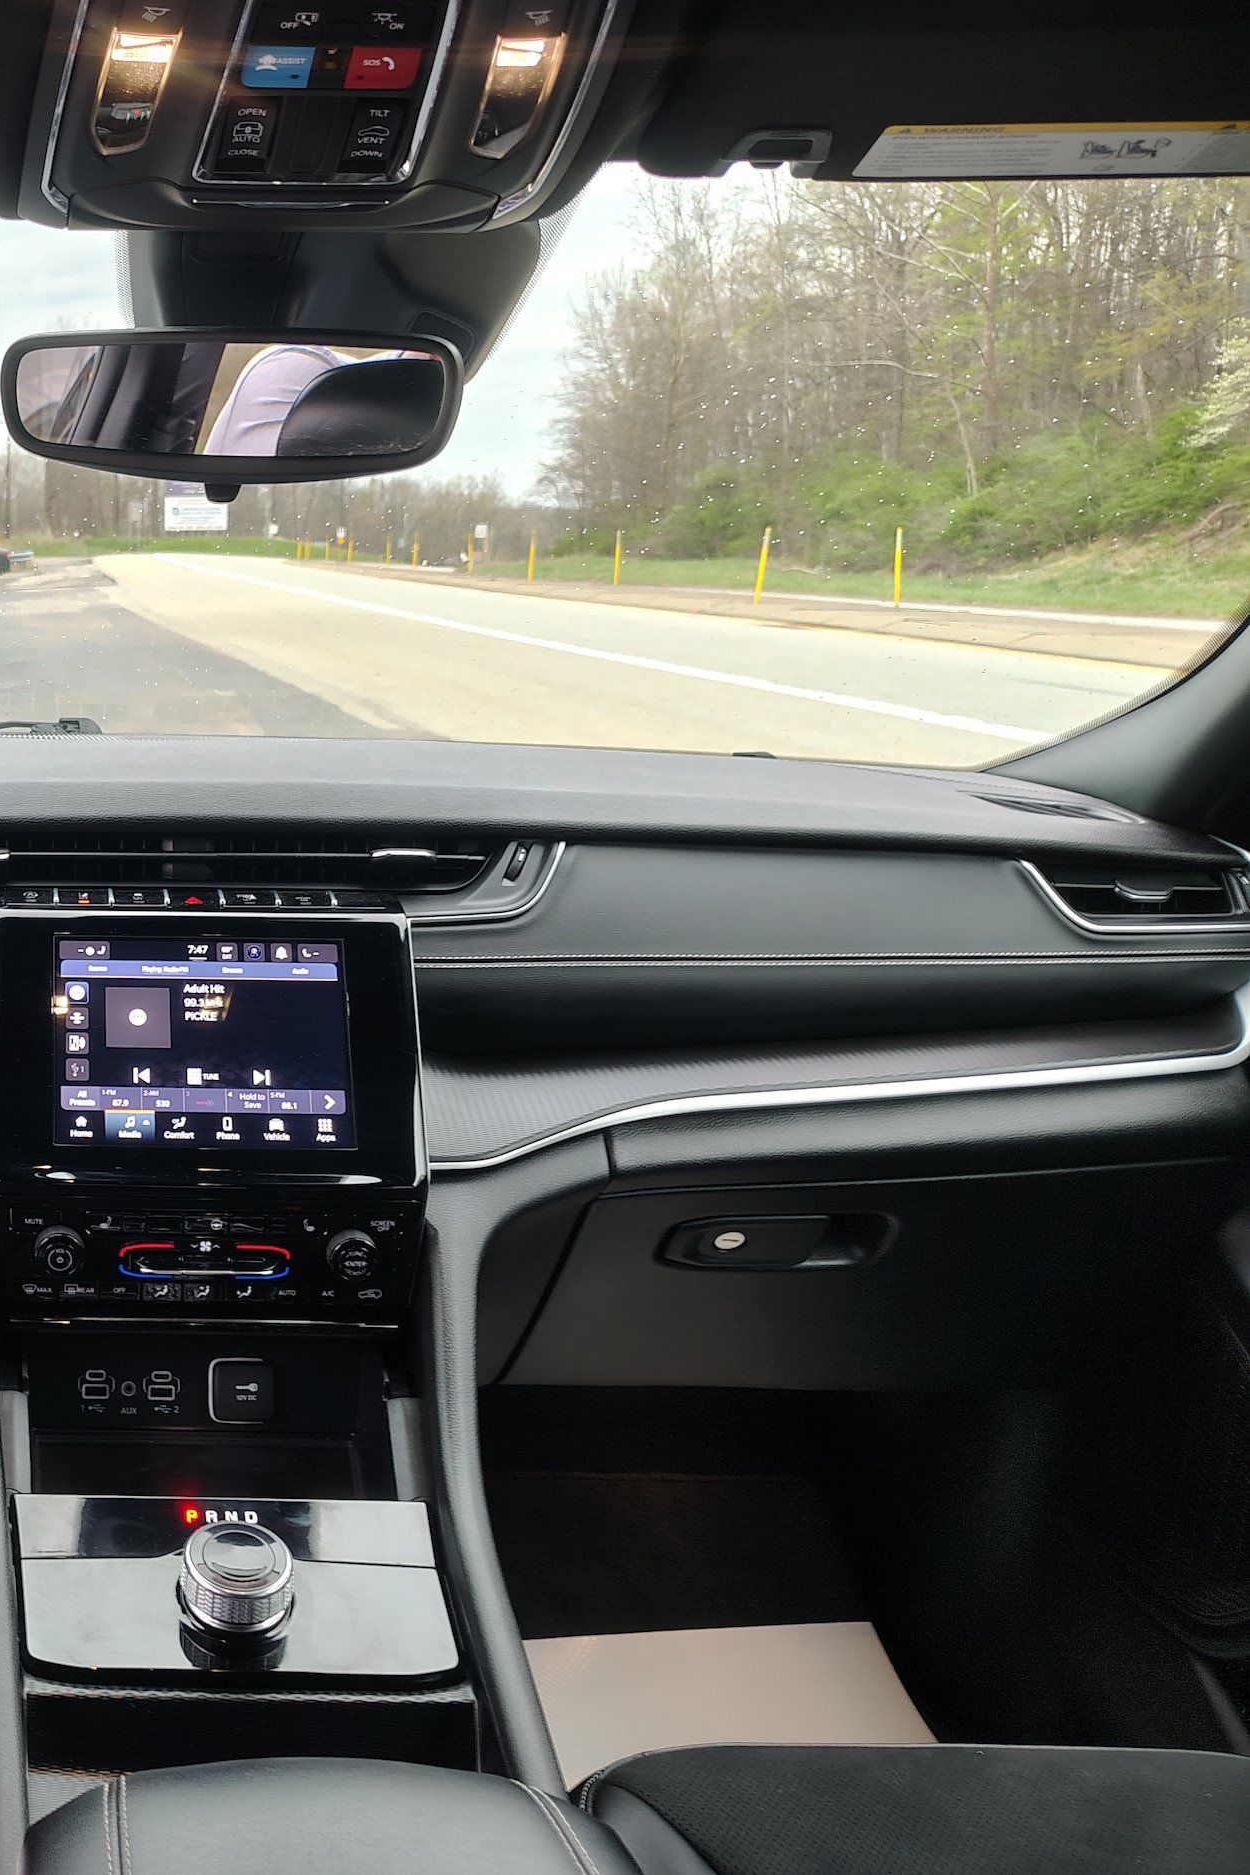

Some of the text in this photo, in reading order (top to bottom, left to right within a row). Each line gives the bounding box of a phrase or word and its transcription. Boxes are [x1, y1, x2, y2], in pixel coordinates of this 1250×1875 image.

[280, 22, 299, 30] OFF
[276, 57, 306, 65] ASSIST
[362, 59, 381, 67] SOS
[237, 108, 267, 117] OPEN
[369, 109, 391, 118] TILT
[232, 135, 261, 143] AUTO
[357, 137, 385, 145] VENT
[228, 149, 259, 157] CLOSE
[350, 150, 383, 158] DOWN
[187, 945, 209, 955] 7:47
[183, 984, 225, 994] Adult Hit
[244, 1101, 262, 1109] Save
[69, 1129, 336, 1143] Home Media Comfort Phone Vehicle Apps
[120, 1407, 138, 1415] AUX
[186, 1509, 258, 1524] P R N D
